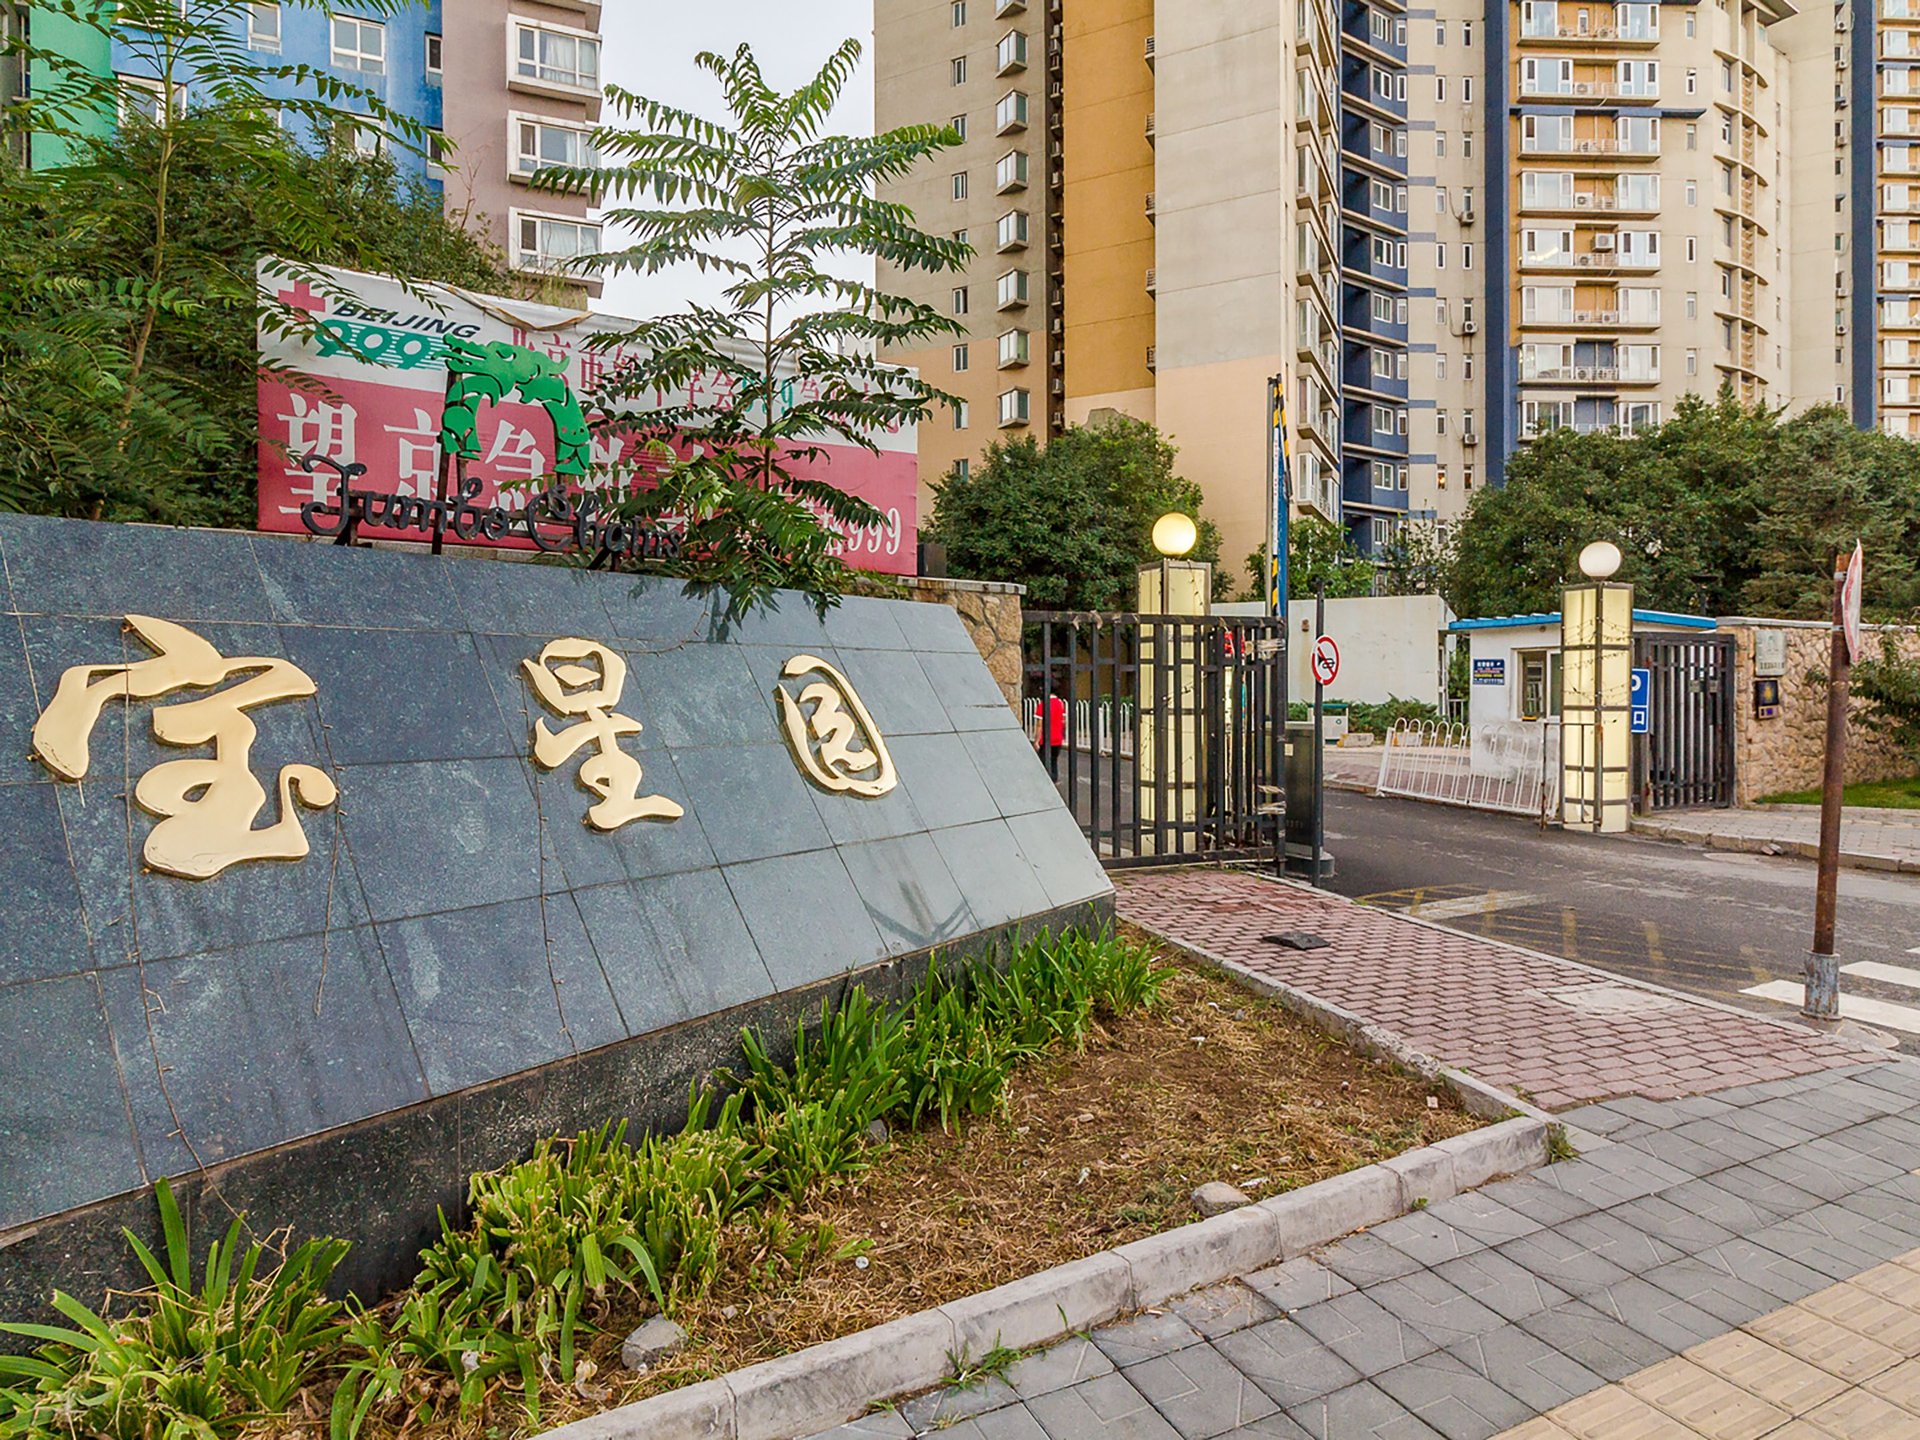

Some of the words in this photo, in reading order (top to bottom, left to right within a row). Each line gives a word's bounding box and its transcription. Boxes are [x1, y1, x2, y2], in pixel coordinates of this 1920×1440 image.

[332, 301, 481, 339] BEIJING
[301, 453, 510, 541] Jumbo
[31, 614, 899, 880] 宝星园
